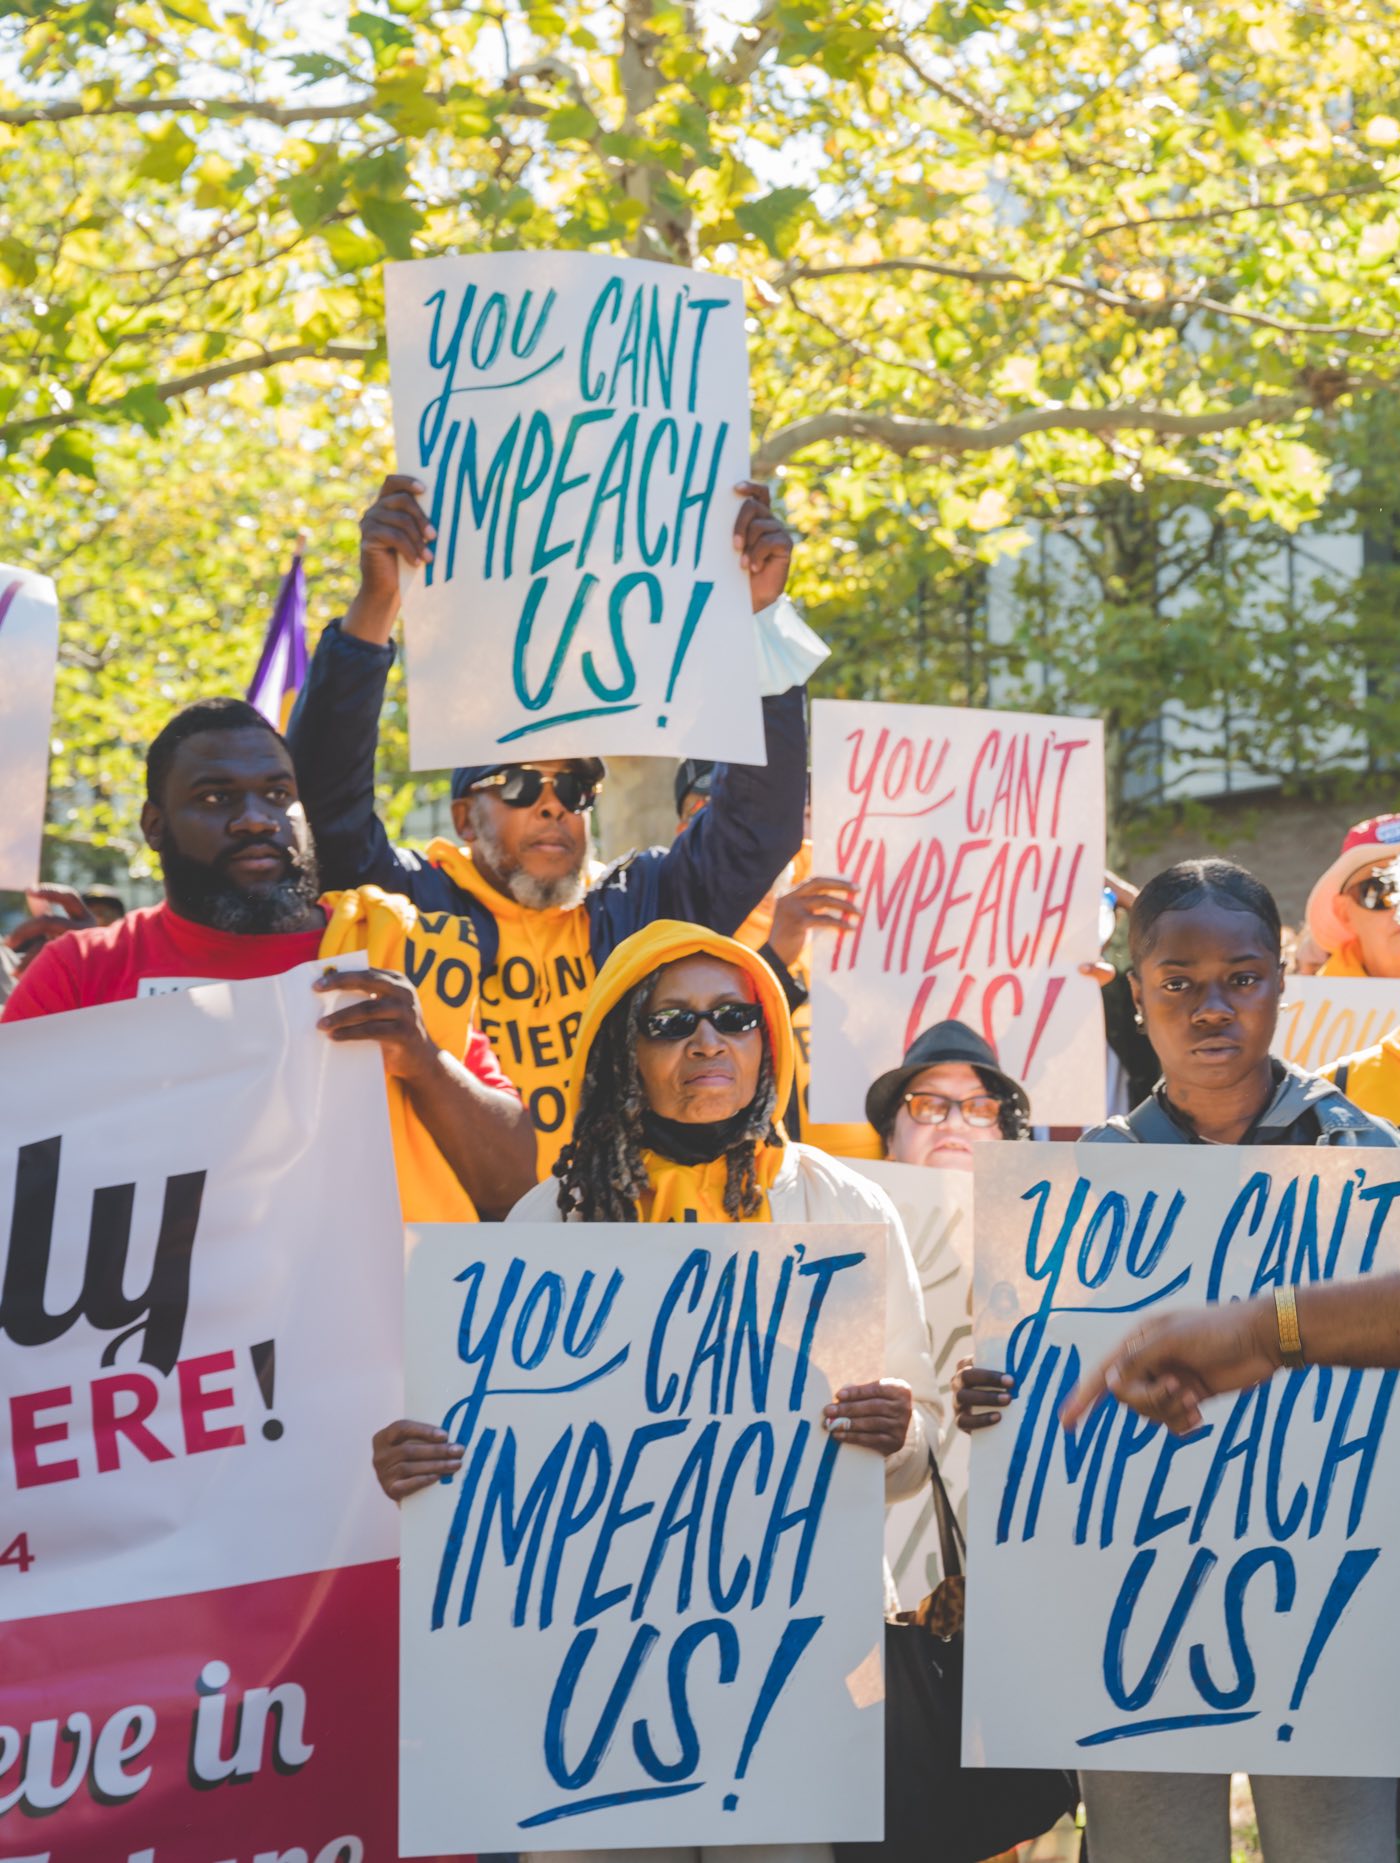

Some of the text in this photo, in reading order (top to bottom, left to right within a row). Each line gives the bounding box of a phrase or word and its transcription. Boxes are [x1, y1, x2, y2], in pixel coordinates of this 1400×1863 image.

[418, 276, 730, 468] YOU CAN'T
[424, 407, 730, 586] IMPEACH
[510, 571, 715, 729] US!
[837, 728, 1090, 874] YOU CAN'T
[830, 837, 1086, 973] IMPEACH
[440, 1256, 632, 1485] YOU
[644, 1243, 867, 1417] CAN'T
[1006, 1176, 1192, 1399] YOU
[430, 1418, 842, 1632] IMPEACH
[190, 1659, 315, 1790] in
[542, 1614, 825, 1812] US!
[1102, 1545, 1382, 1742] US!
